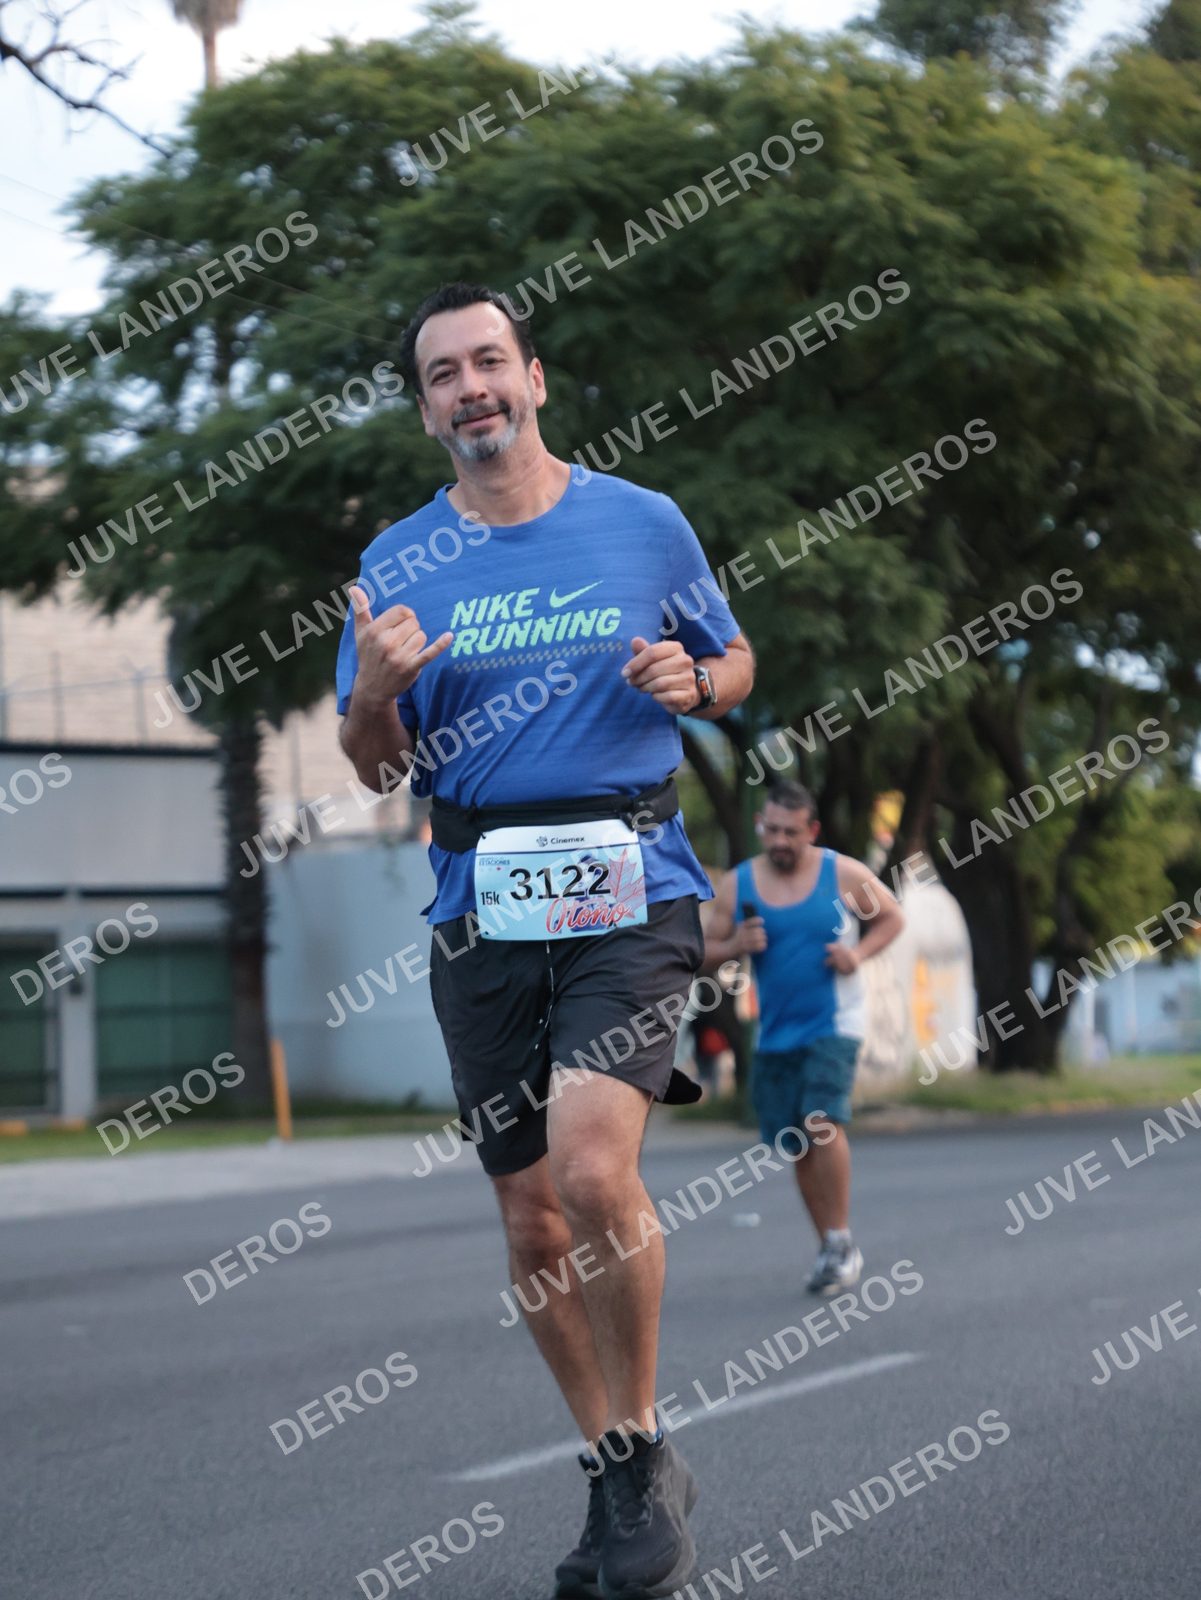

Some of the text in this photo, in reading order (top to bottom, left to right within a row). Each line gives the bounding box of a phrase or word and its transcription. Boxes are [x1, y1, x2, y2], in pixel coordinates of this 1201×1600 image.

[450, 587, 540, 629] NIKE
[451, 607, 622, 658] RUNNING
[550, 836, 585, 845] Cinemex
[480, 891, 500, 906] 15k
[509, 863, 611, 901] 3122
